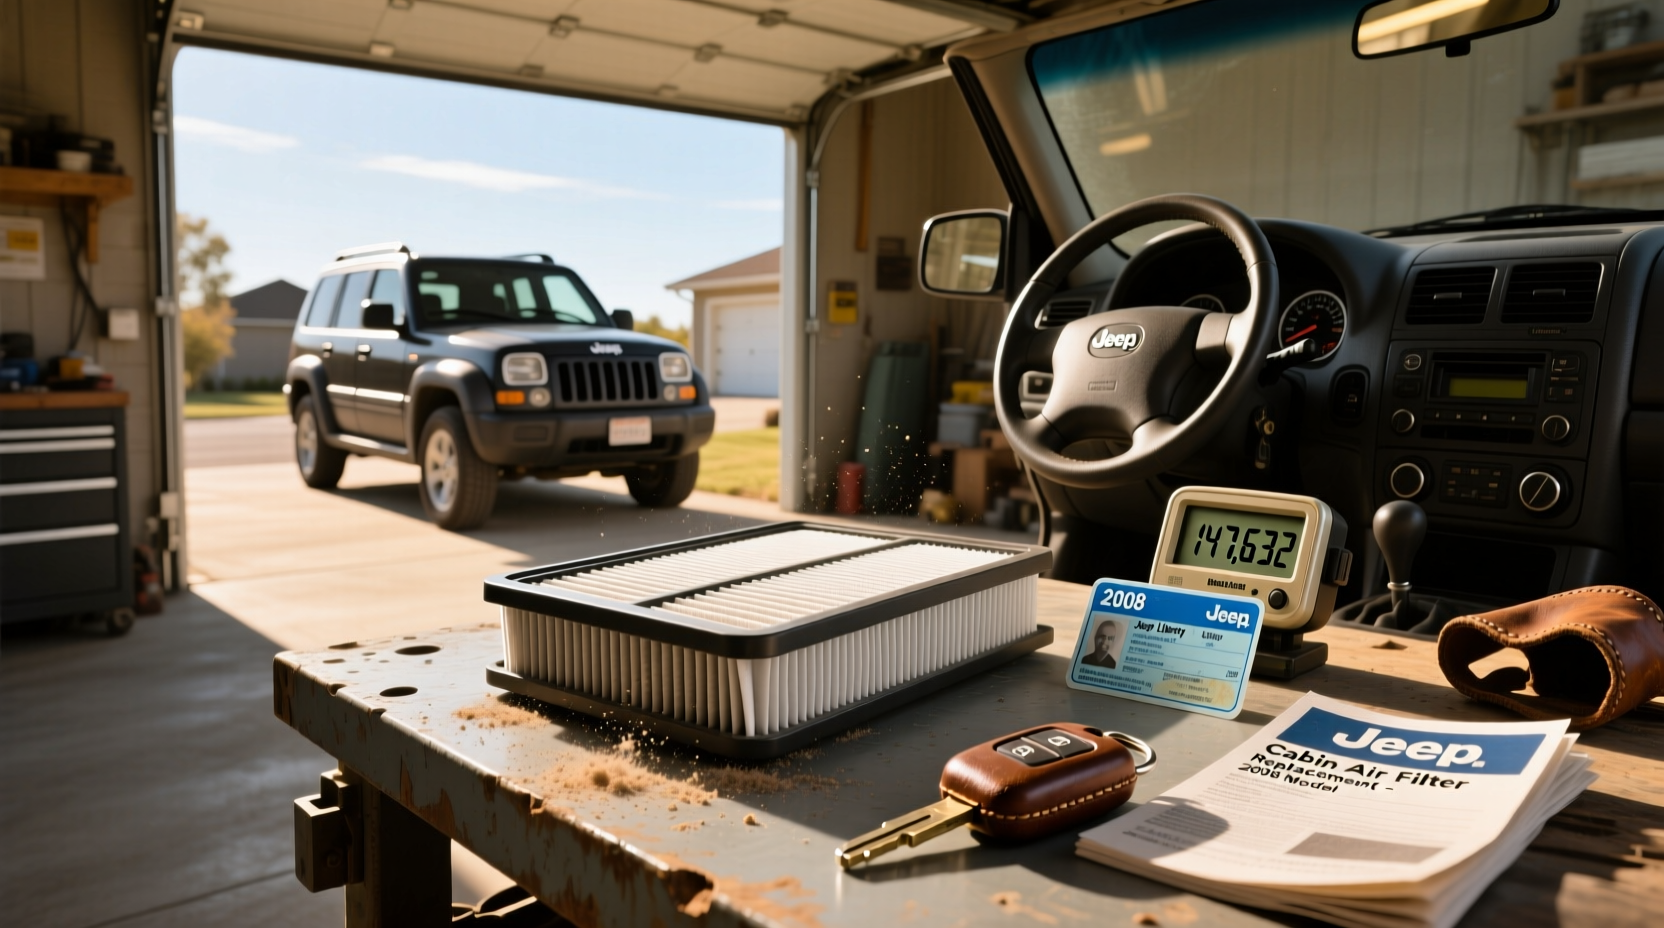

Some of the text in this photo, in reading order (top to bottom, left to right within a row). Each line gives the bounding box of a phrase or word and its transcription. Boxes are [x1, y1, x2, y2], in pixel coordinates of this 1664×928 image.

[1091, 328, 1137, 350] Jeep
[1193, 523, 1297, 568] 147,632
[1100, 588, 1146, 611] 2008
[1266, 743, 1470, 790] Cabin Air Filter
[1283, 774, 1338, 793] Model
